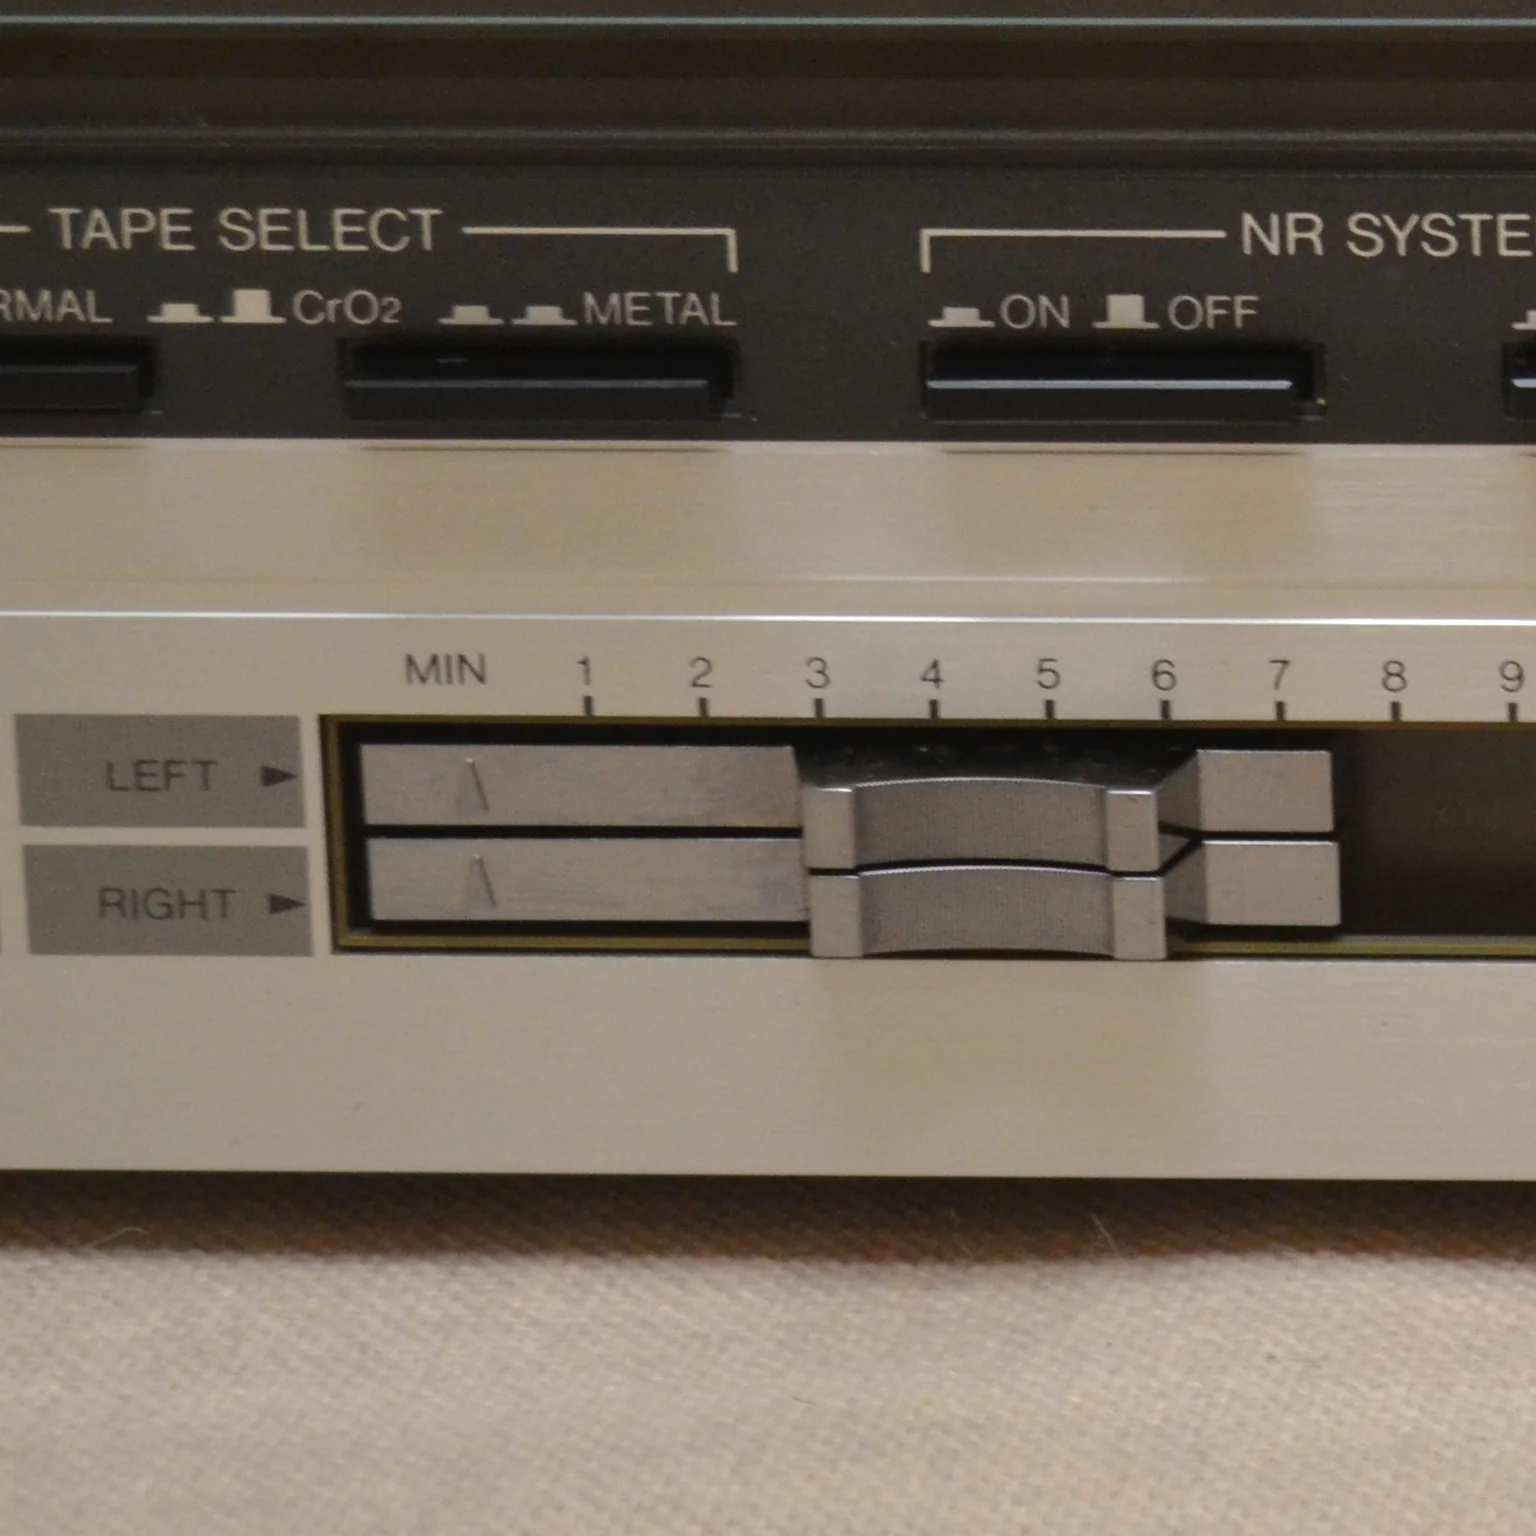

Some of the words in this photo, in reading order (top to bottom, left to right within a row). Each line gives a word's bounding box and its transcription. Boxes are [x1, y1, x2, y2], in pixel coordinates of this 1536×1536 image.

[49, 207, 195, 251] TAPE
[219, 207, 442, 252] SELECT
[1242, 212, 1323, 255] NR
[584, 291, 736, 326] METAL
[1000, 293, 1070, 329] ON
[1168, 294, 1259, 330] OFF
[405, 653, 486, 684] MIN
[576, 657, 592, 686] 1
[690, 656, 713, 688] 2
[806, 656, 831, 689] 3
[921, 660, 943, 688] 4
[1037, 658, 1060, 690] 5
[1151, 659, 1177, 691] 6
[1269, 658, 1291, 690] 7
[1382, 660, 1407, 693] 8
[1499, 660, 1525, 693] 9
[105, 758, 217, 792] LEFT
[98, 886, 235, 920] RIGHT
